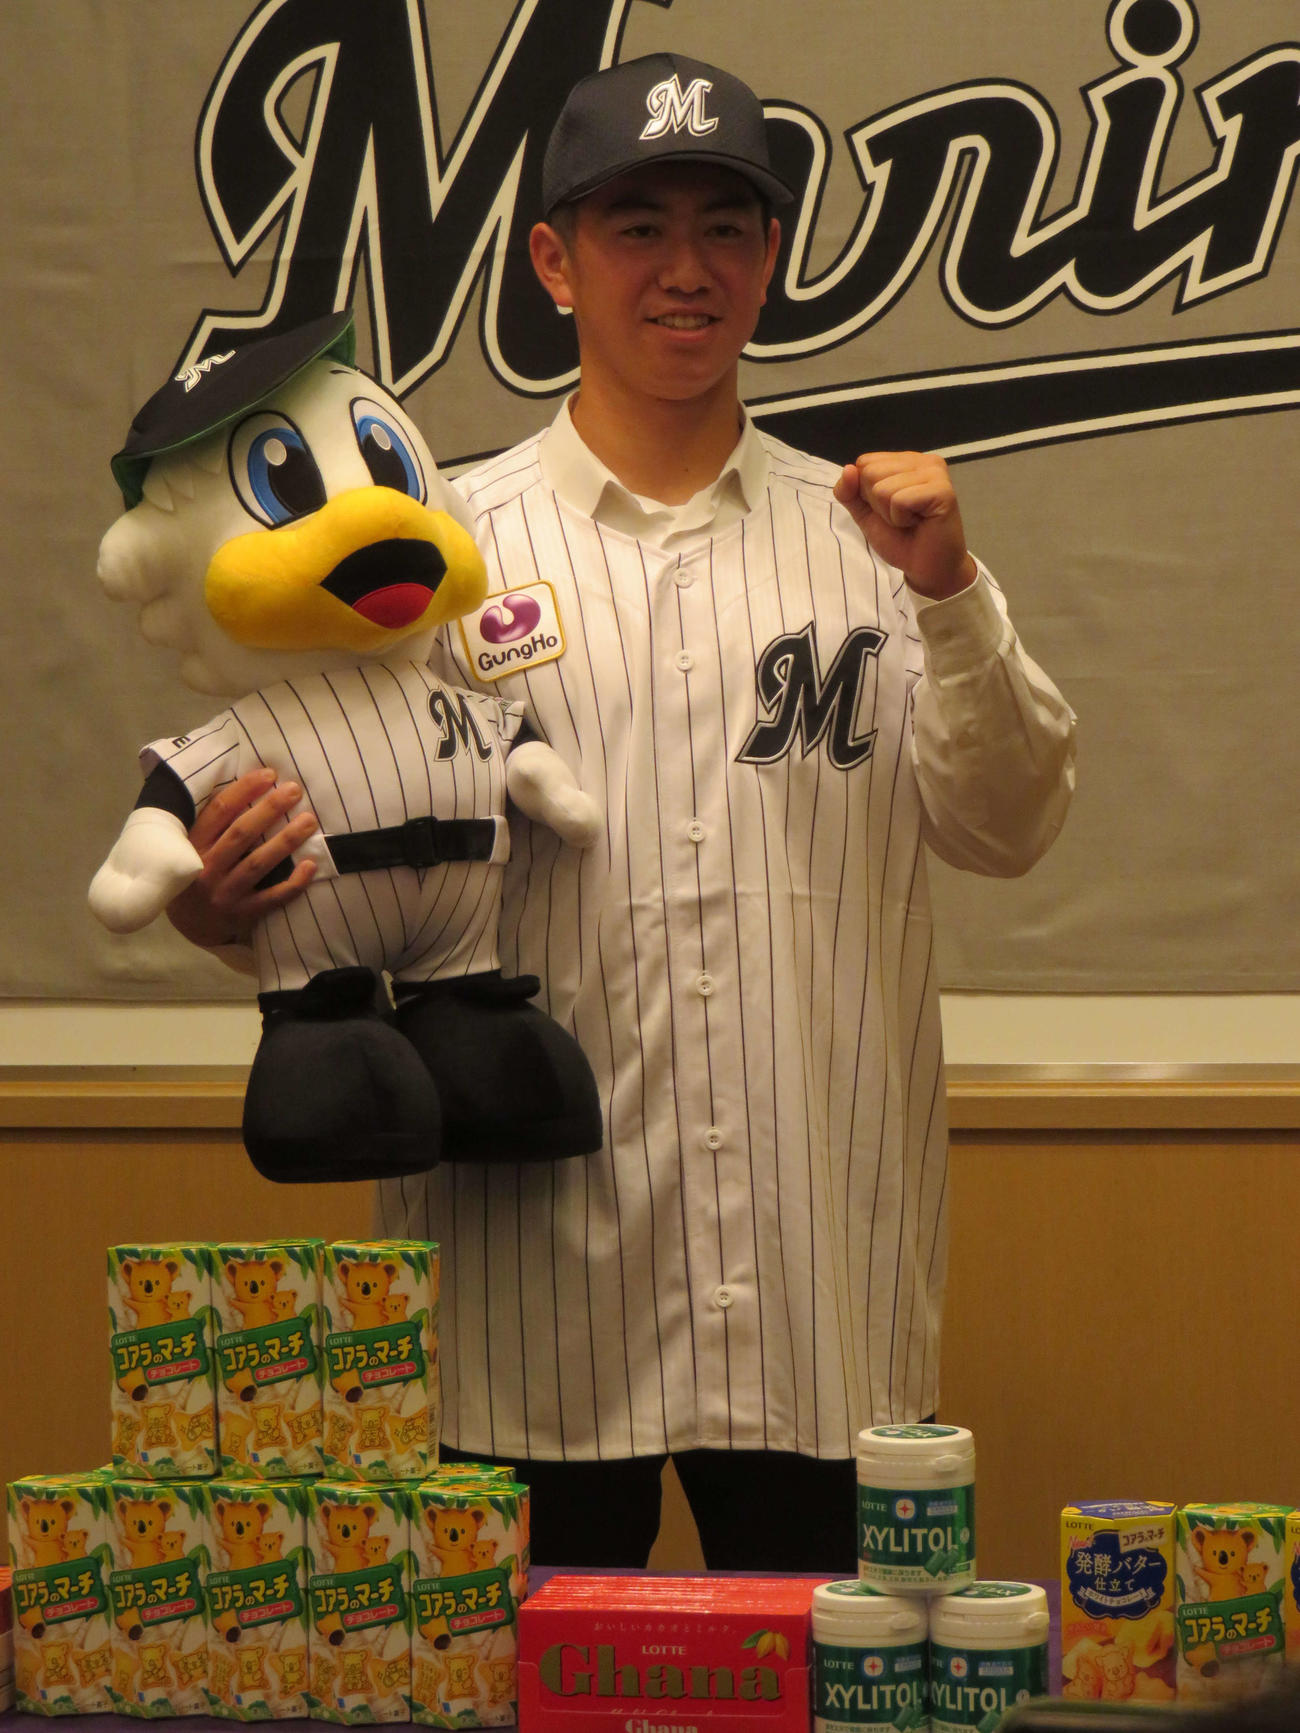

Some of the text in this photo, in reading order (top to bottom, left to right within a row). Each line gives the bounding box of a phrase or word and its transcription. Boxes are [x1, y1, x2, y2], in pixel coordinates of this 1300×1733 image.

[639, 73, 720, 141] M
[478, 632, 559, 673] GungHo
[734, 619, 889, 771] M
[426, 684, 494, 763] M
[117, 1332, 197, 1371] コアラのマーチ
[223, 1331, 305, 1371] コアラのマーチ
[331, 1335, 413, 1371] コアラのマーチ
[150, 1361, 199, 1379] チョコレート
[259, 1360, 305, 1378] チョコレート
[365, 1364, 414, 1381] チョコレート
[862, 1500, 888, 1512] LOTTE
[862, 1523, 958, 1553] XYLITOL
[1075, 1551, 1162, 1576] 発酵バター
[17, 1570, 95, 1607] コアラのマーチ
[114, 1571, 192, 1608] コアラのマーチ
[211, 1573, 290, 1610] コアラのマーチ
[314, 1577, 395, 1613] コアラのマーチ
[419, 1581, 503, 1618] コアラのマーチ
[1094, 1577, 1137, 1592] 仕立て
[46, 1598, 96, 1617] チョコレート
[144, 1599, 193, 1619] チョコレート
[241, 1602, 291, 1621] チョコレート
[347, 1606, 396, 1625] チョコレート
[453, 1611, 503, 1629] チョコレート
[1184, 1606, 1273, 1643] コアラのマーチ
[641, 1644, 688, 1657] LOTTE
[823, 1657, 856, 1671] LOTTE
[539, 1643, 784, 1702] Ghana
[824, 1681, 923, 1711] XYLITOL
